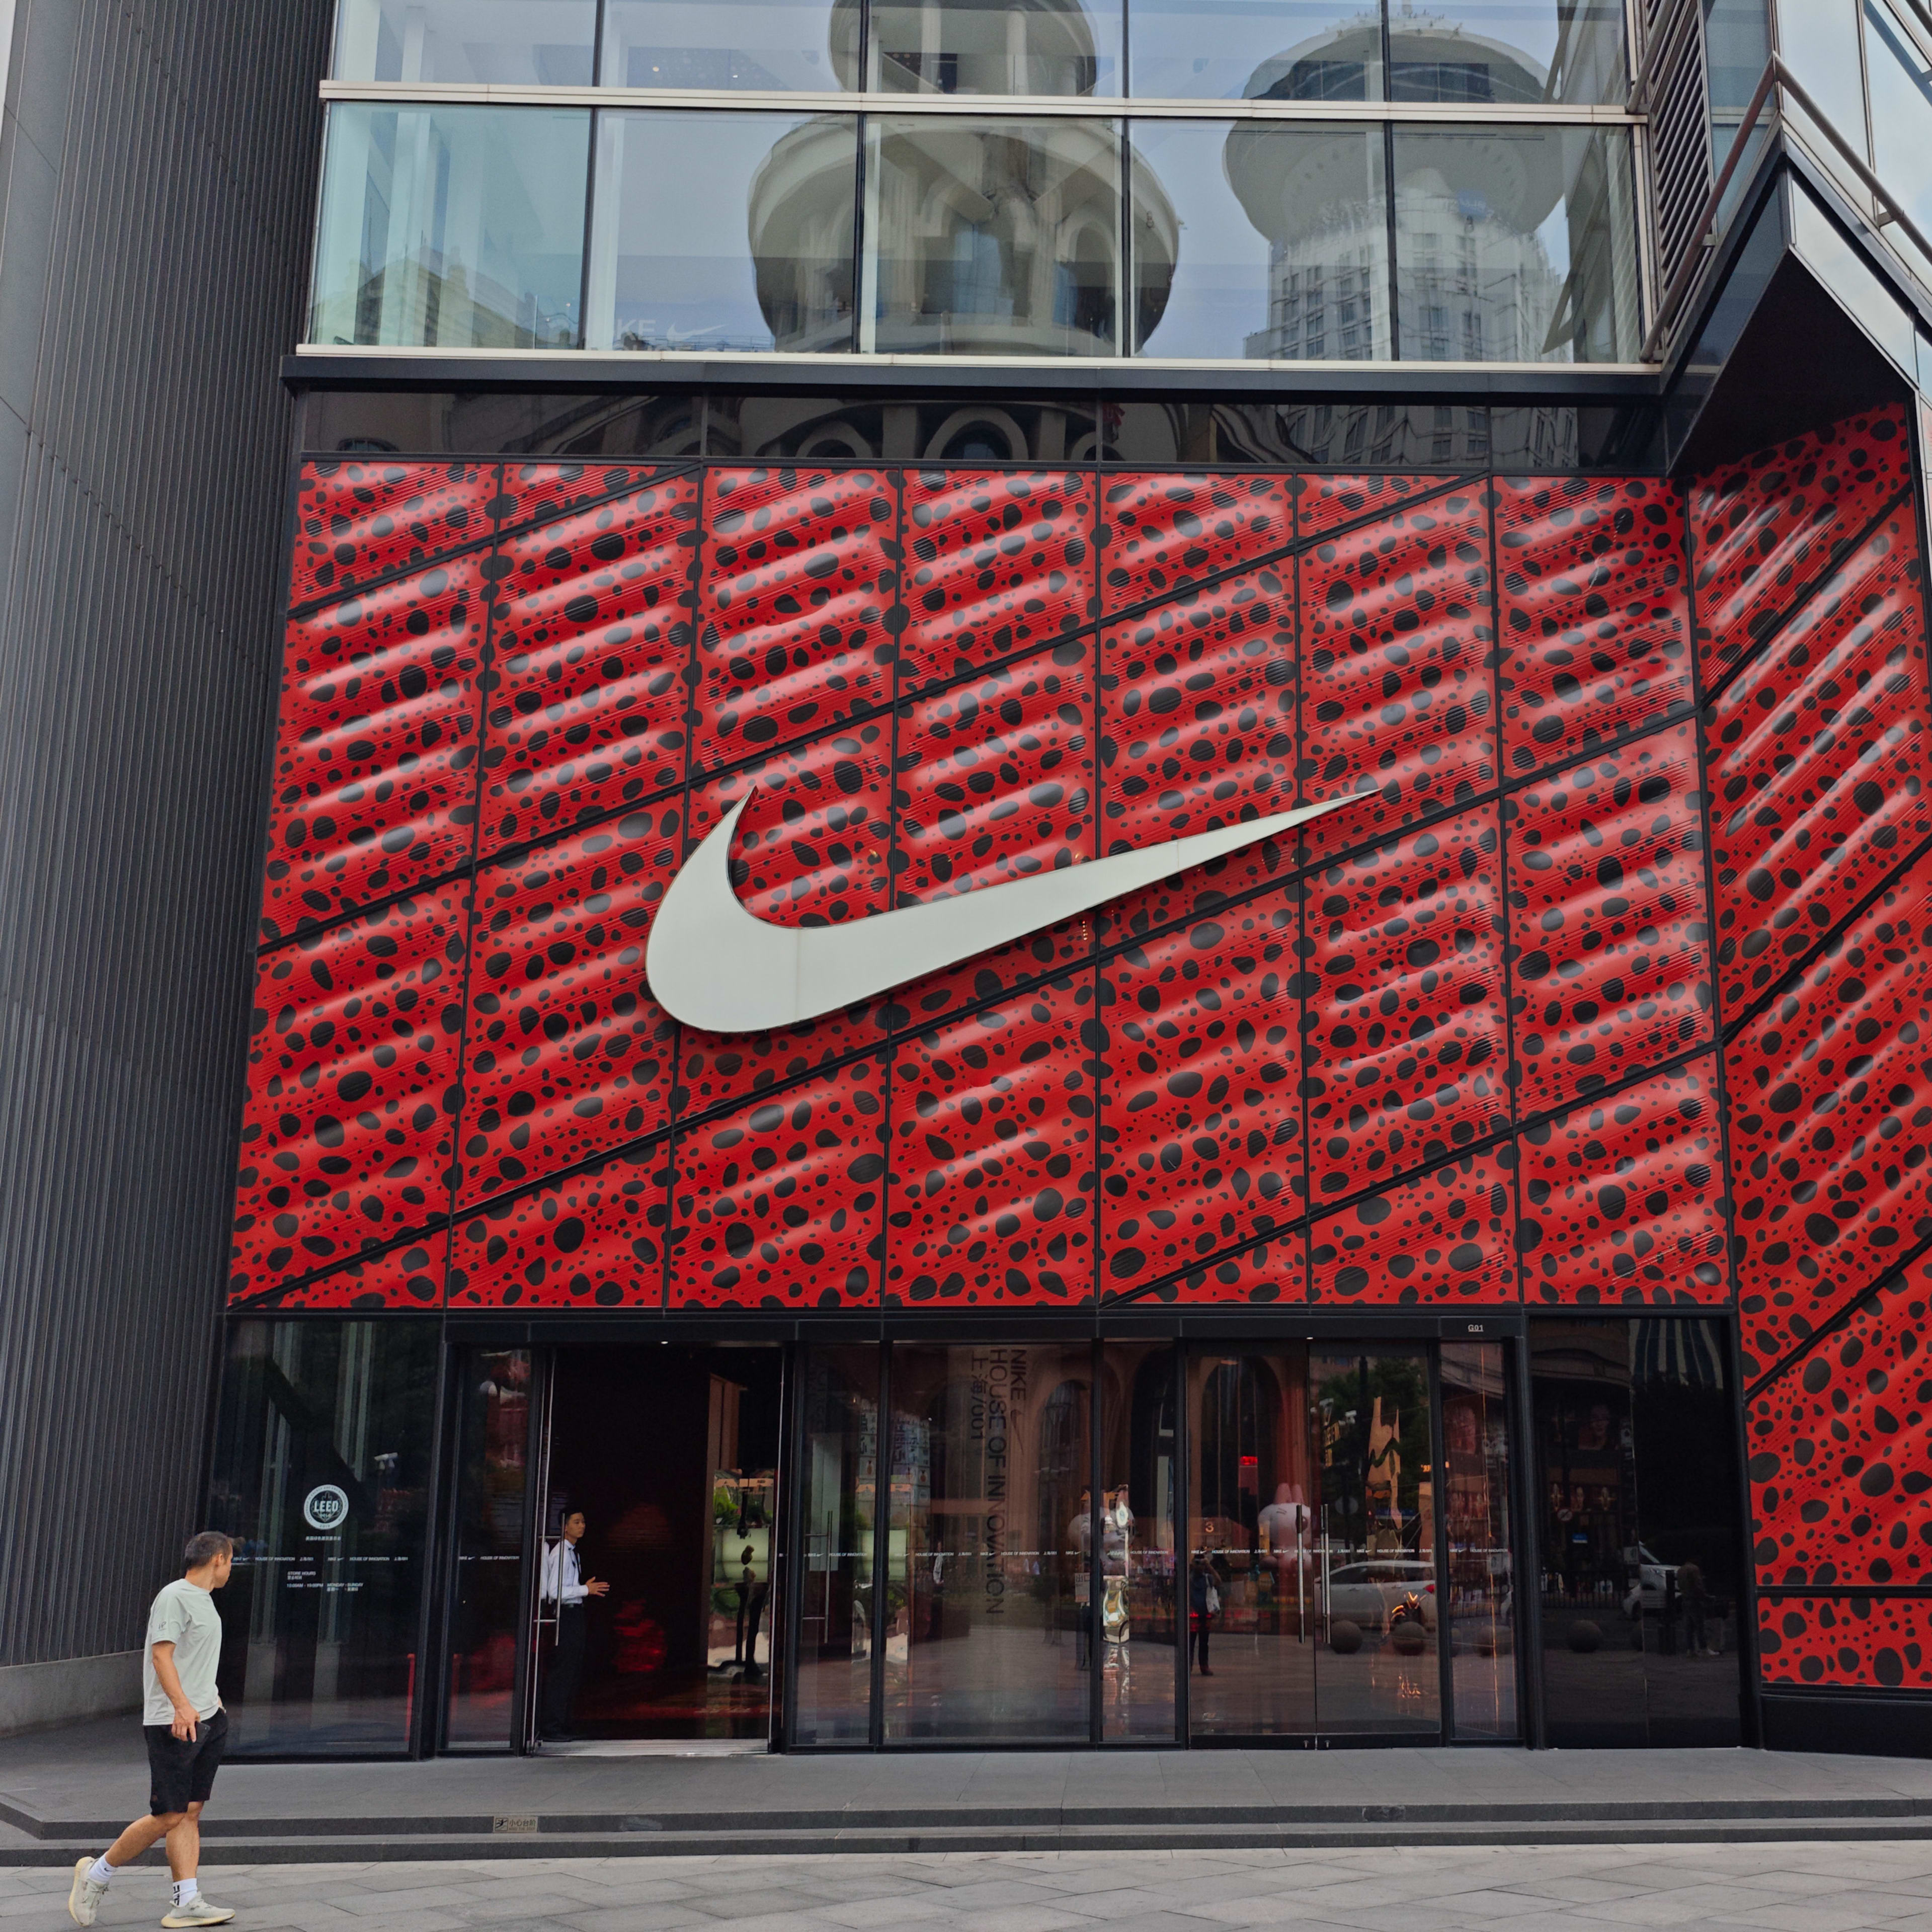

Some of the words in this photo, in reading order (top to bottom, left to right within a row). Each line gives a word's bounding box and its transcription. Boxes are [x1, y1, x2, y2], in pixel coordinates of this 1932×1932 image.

[1468, 1324, 1484, 1332] G01
[989, 1349, 1007, 1429] HOUSE
[1010, 1349, 1027, 1400] NIKE
[988, 1436, 1007, 1468] OF
[314, 1500, 339, 1512] LEED
[986, 1475, 1006, 1614] INNOVATION
